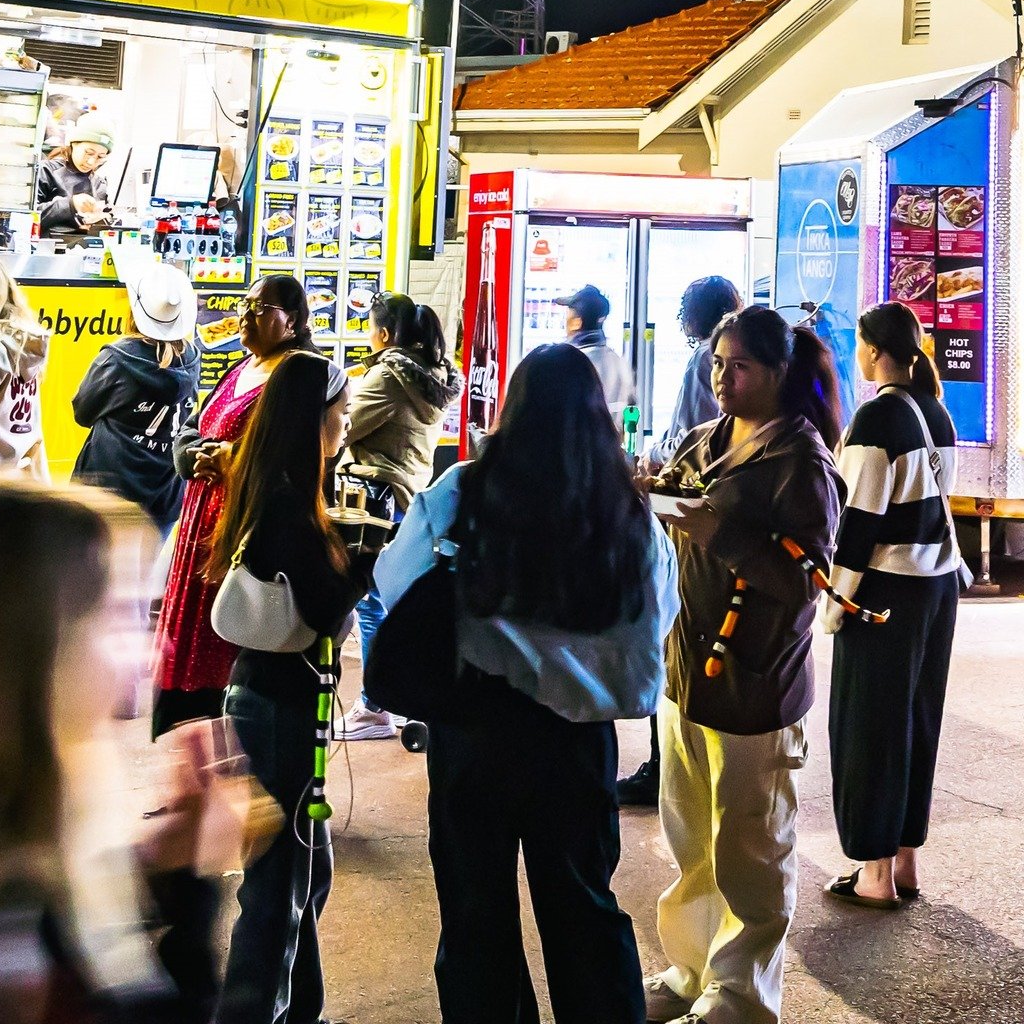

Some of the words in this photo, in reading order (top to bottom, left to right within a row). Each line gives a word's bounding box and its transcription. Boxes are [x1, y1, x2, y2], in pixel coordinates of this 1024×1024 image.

[805, 225, 830, 251] TIKKA
[801, 252, 833, 278] TANGO
[38, 308, 123, 341] bbydu
[949, 338, 969, 347] HOT
[945, 349, 973, 358] CHIPS
[947, 360, 971, 369] $8.00
